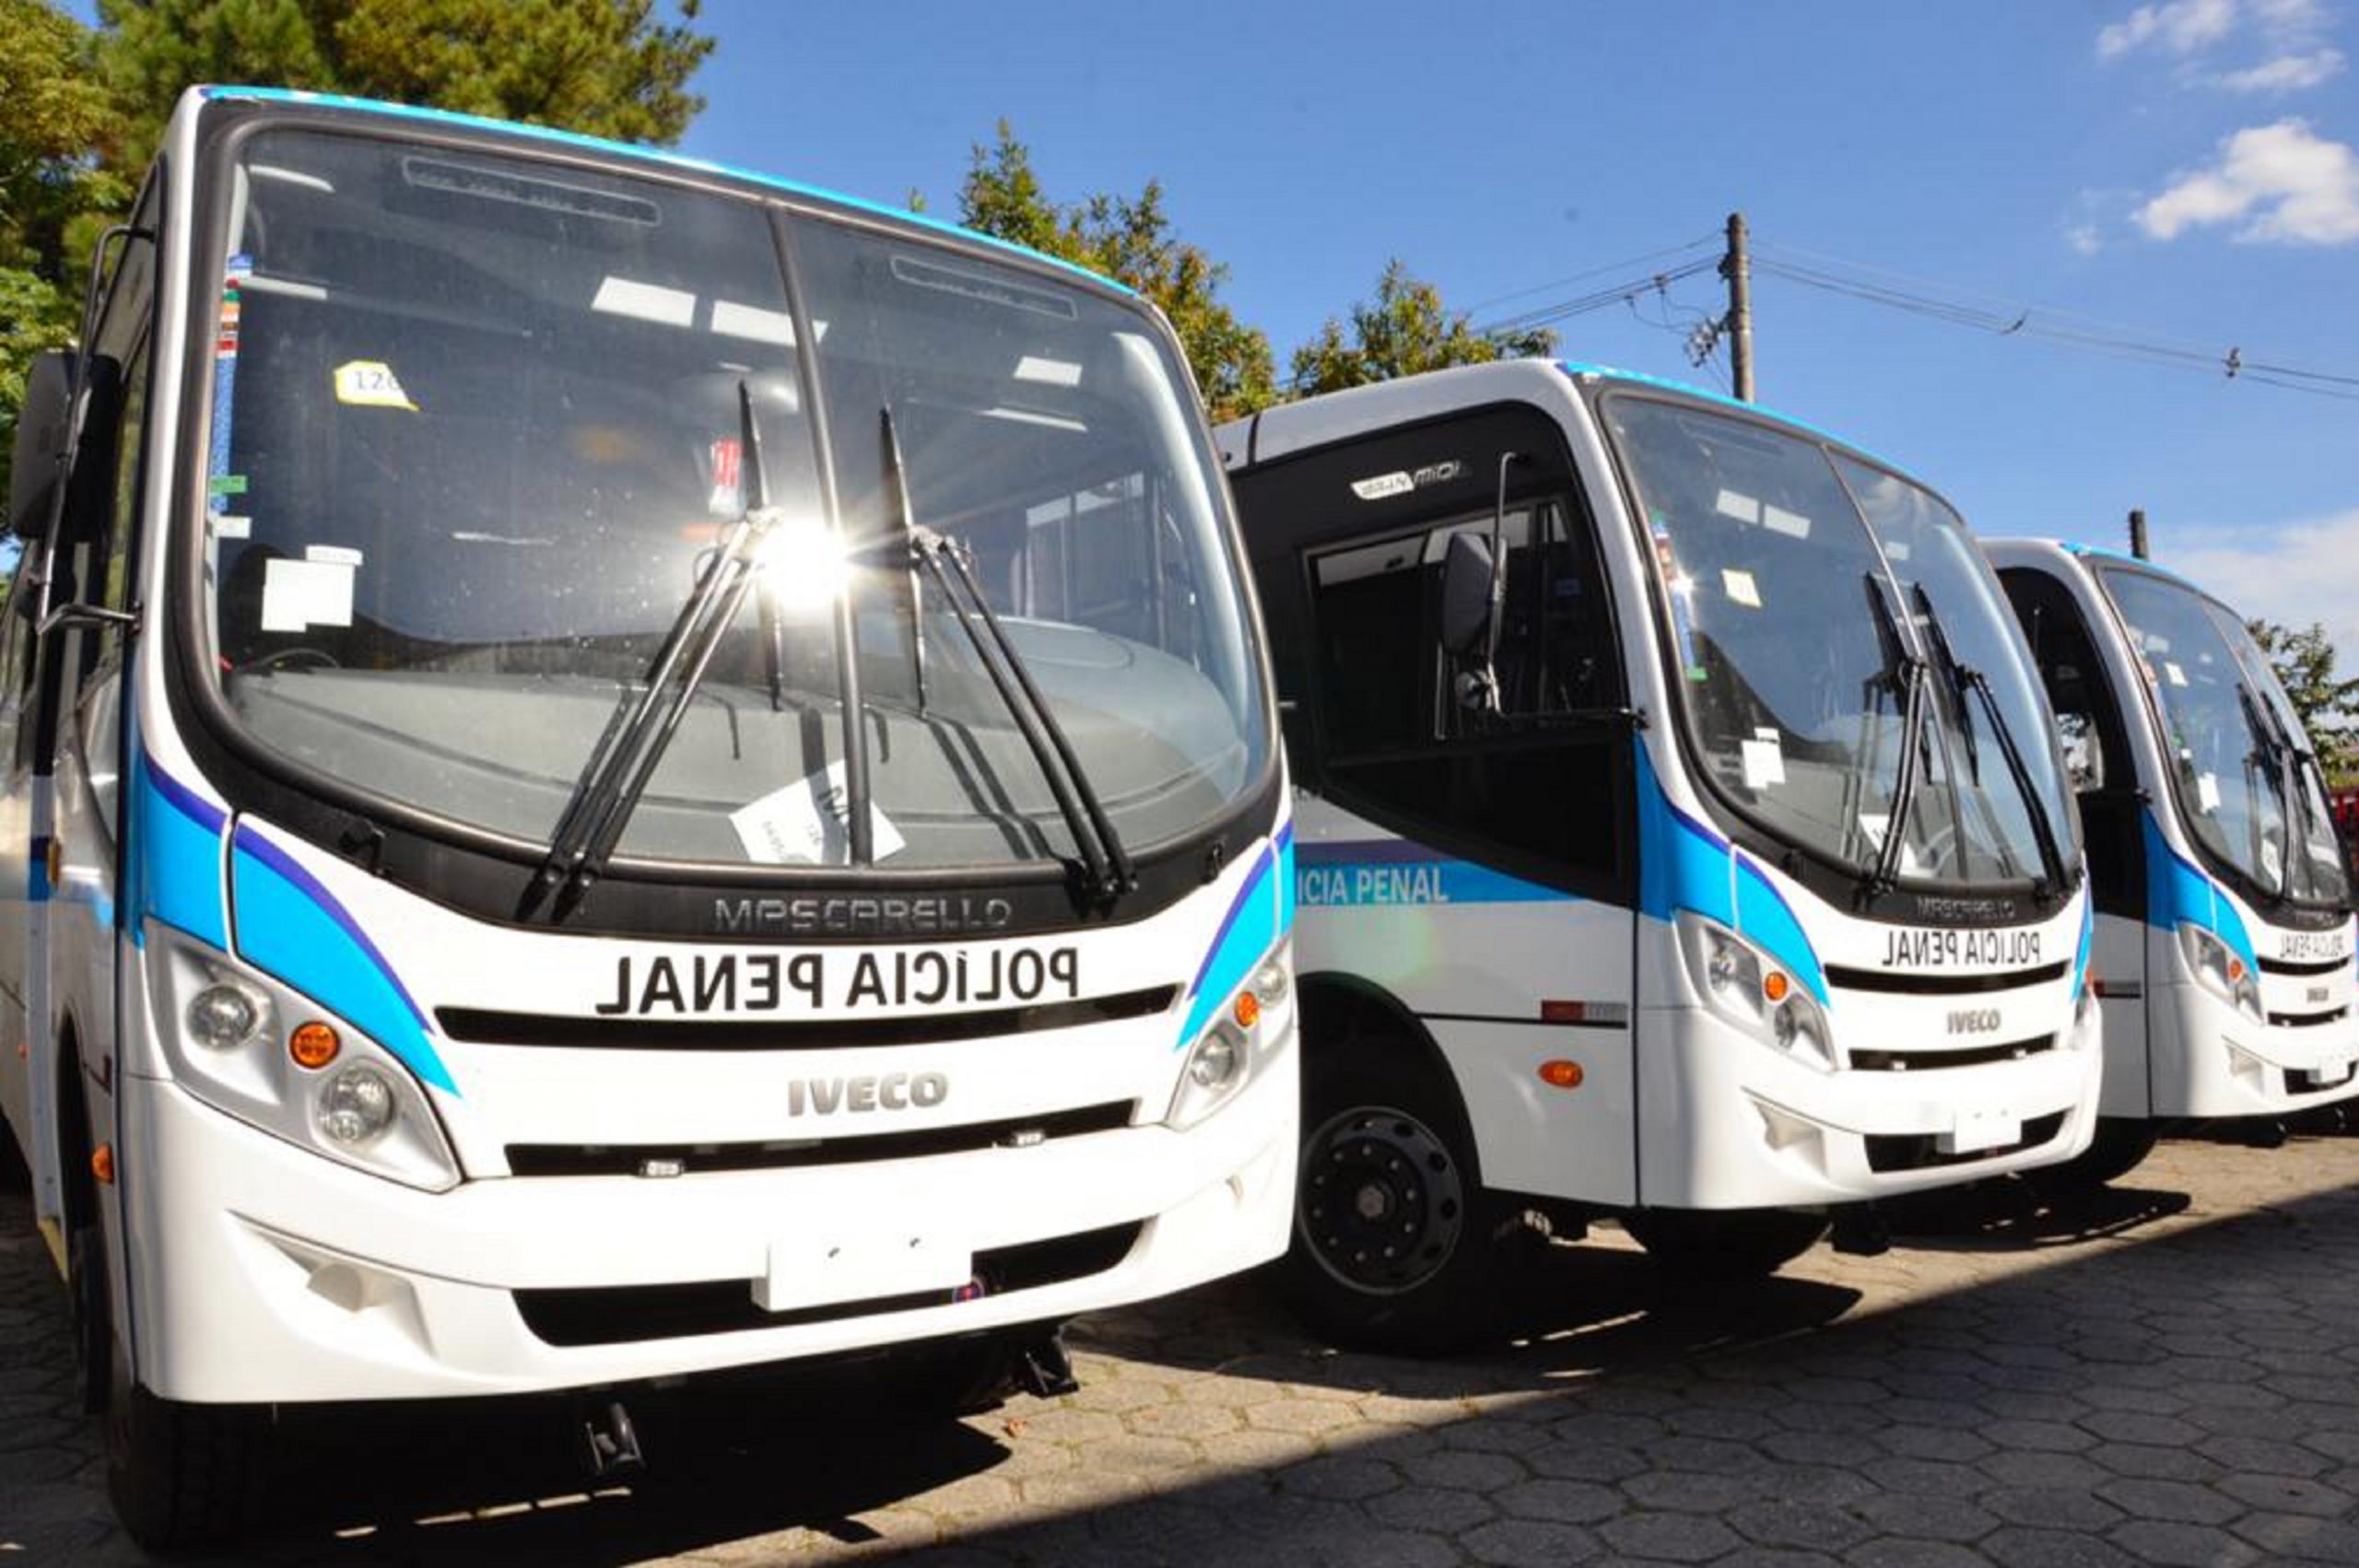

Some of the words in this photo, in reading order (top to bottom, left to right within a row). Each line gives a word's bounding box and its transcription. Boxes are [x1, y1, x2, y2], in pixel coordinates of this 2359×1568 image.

[1356, 867, 1449, 904] PENAL
[1947, 1009, 2001, 1035] IVECO
[788, 1071, 949, 1117] IVECO
